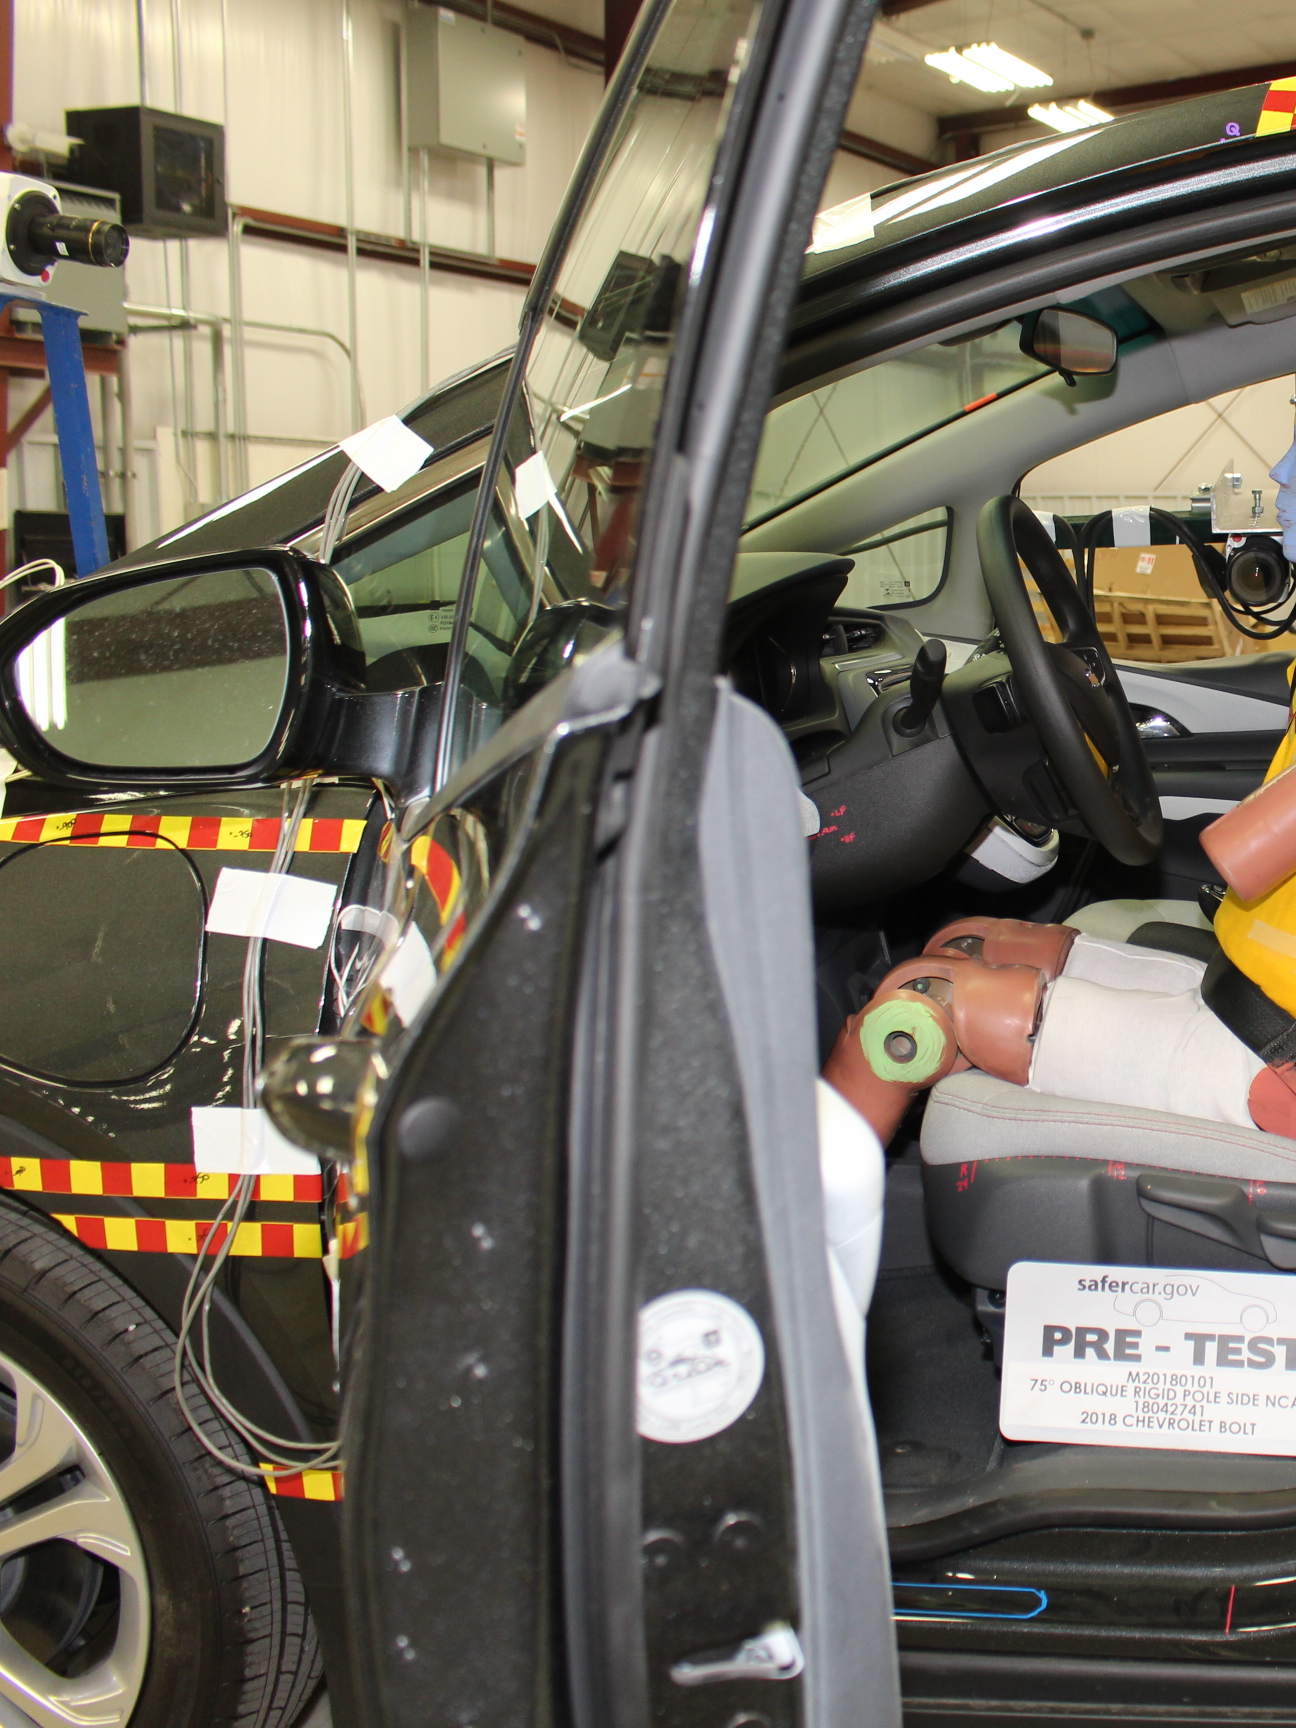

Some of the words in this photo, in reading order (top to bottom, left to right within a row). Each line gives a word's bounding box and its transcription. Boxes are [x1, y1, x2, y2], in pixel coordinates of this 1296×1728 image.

[1225, 122, 1241, 137] Q
[1077, 1274, 1201, 1300] safercar.gov
[1041, 1324, 1143, 1363] PRE
[1030, 1378, 1055, 1393] 75°
[1059, 1380, 1129, 1398] OBLIQUE
[1133, 1385, 1178, 1402] RIGID
[1182, 1388, 1222, 1405] POLE
[1226, 1391, 1261, 1407] SIDE
[1126, 1370, 1215, 1389] M20180101
[1133, 1400, 1206, 1418] 18042741
[1080, 1410, 1118, 1427] 2018
[1121, 1413, 1215, 1434] CHEVROLET
[1219, 1420, 1258, 1437] BOLT
